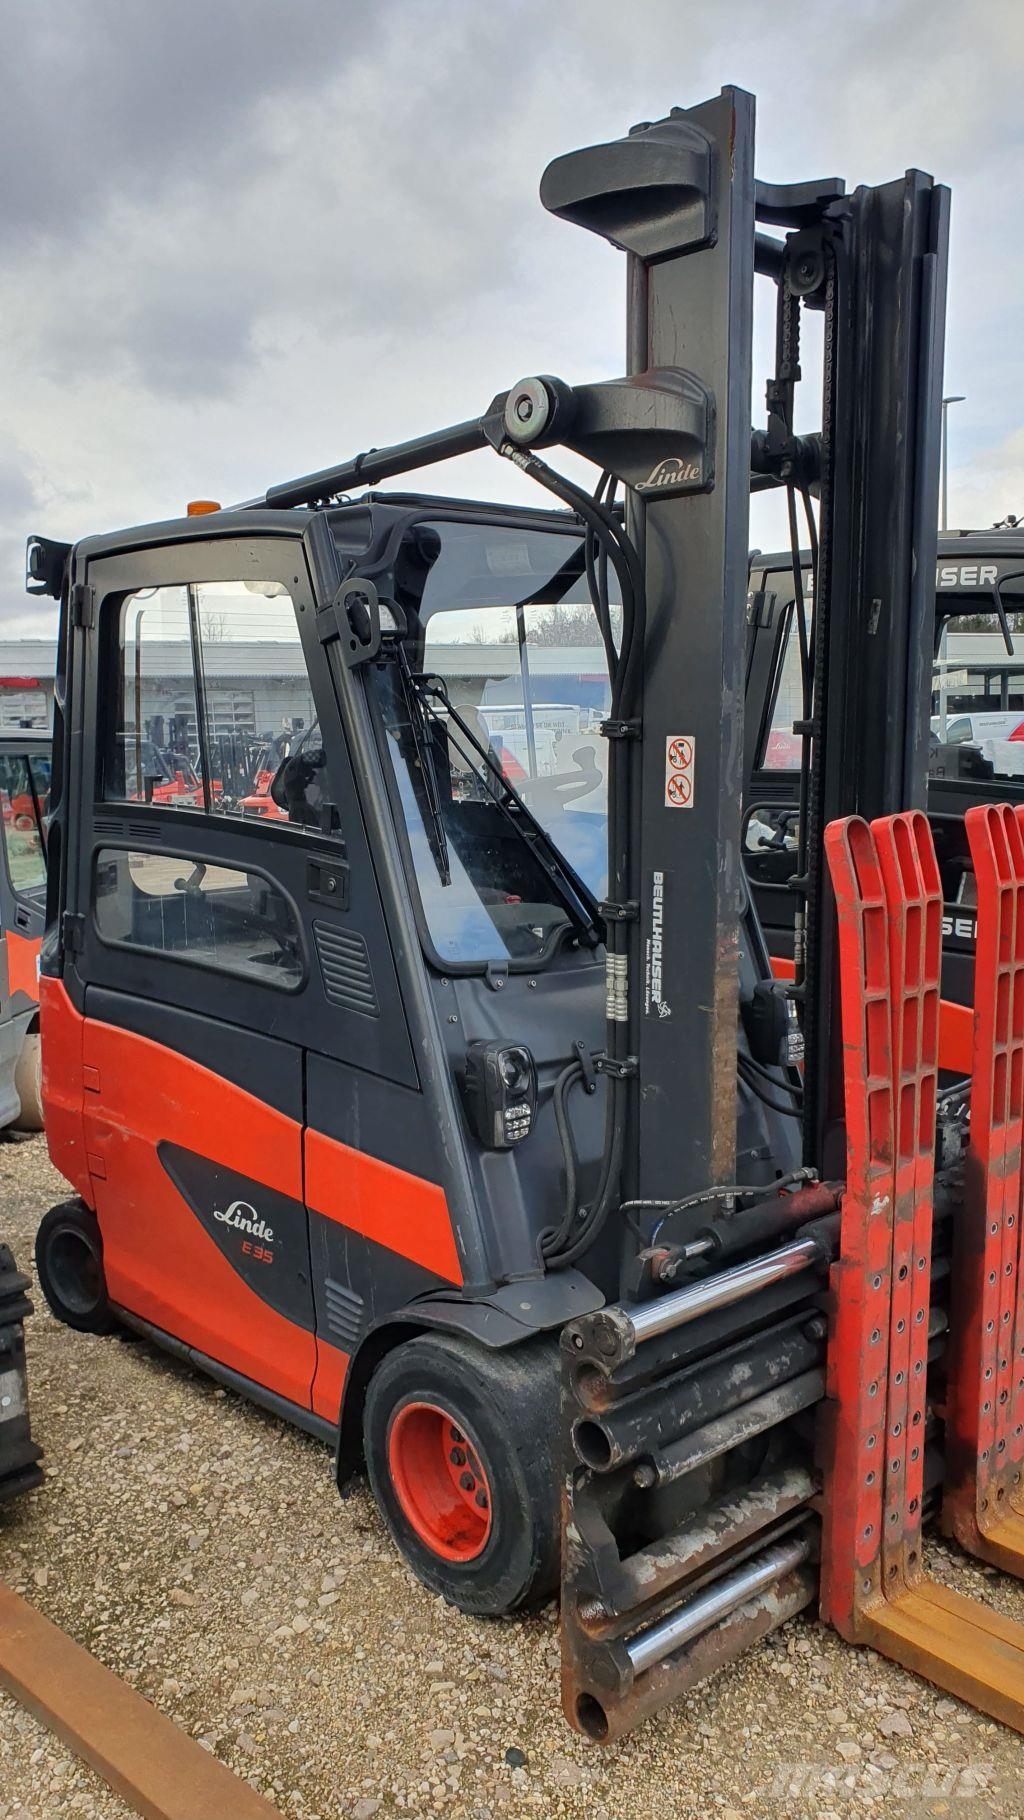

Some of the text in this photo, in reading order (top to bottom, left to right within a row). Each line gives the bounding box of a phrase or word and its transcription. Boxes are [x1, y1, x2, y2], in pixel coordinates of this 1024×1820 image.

[634, 458, 699, 490] Linde
[935, 565, 998, 587] SER
[652, 871, 664, 1003] BEUTLHAUSER
[213, 1201, 274, 1241] Linde
[242, 1240, 274, 1264] E 35
